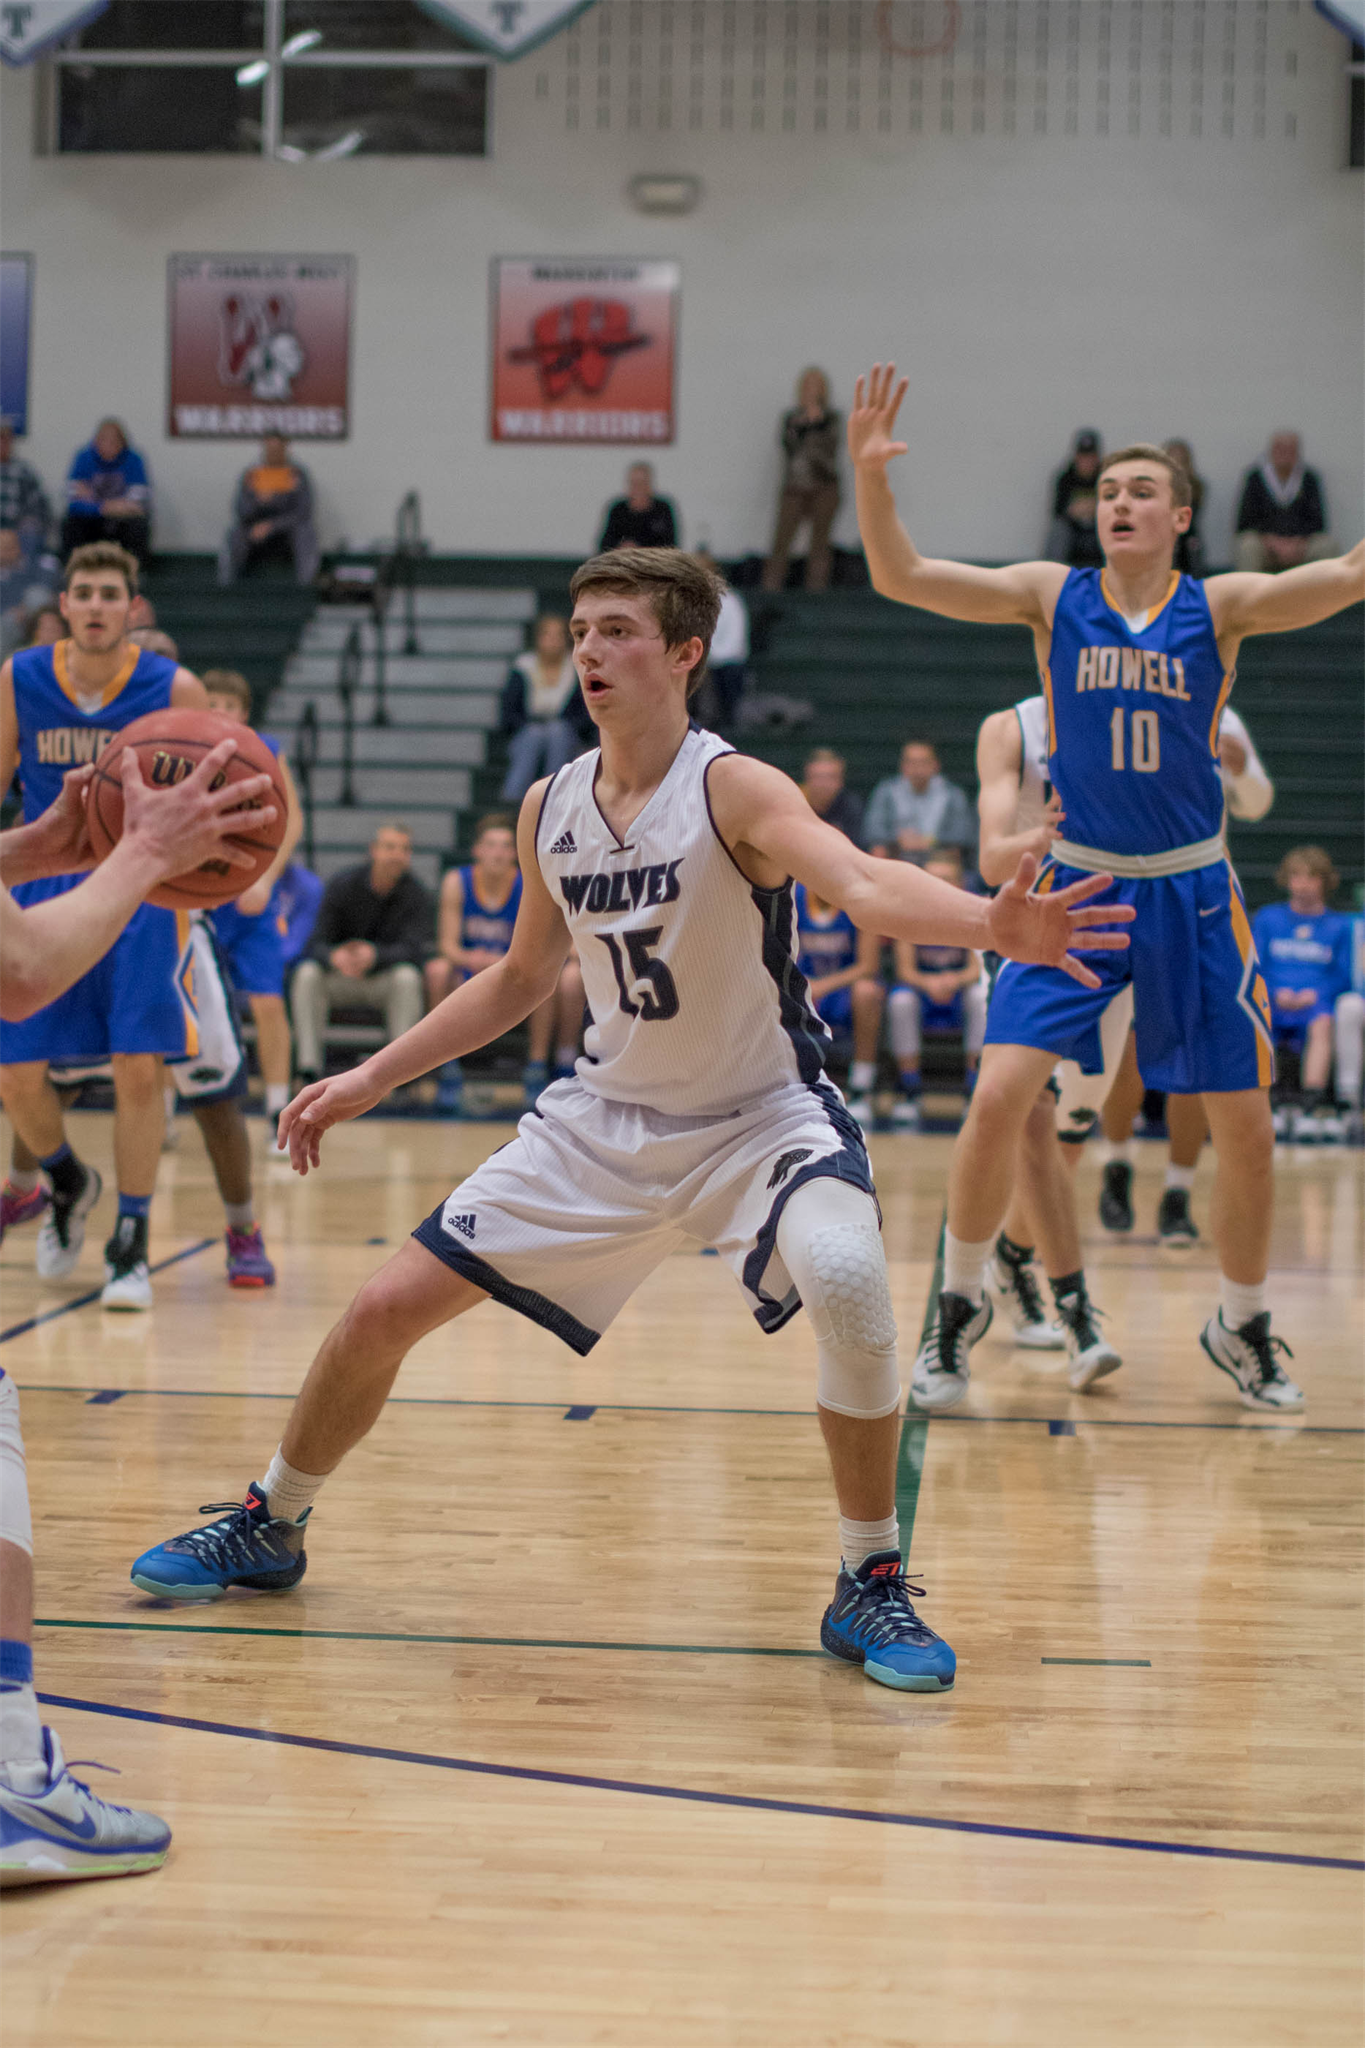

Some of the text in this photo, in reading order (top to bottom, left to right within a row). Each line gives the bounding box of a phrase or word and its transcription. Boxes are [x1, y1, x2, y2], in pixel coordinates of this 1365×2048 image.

[176, 405, 344, 432] WARRIORS
[499, 408, 668, 436] WARRIORS
[1076, 645, 1191, 701] HOWELL
[1110, 706, 1160, 773] 10
[550, 844, 578, 854] adidas
[559, 857, 686, 918] WOLVES
[594, 924, 680, 1022] 15
[447, 1217, 476, 1240] adidas
